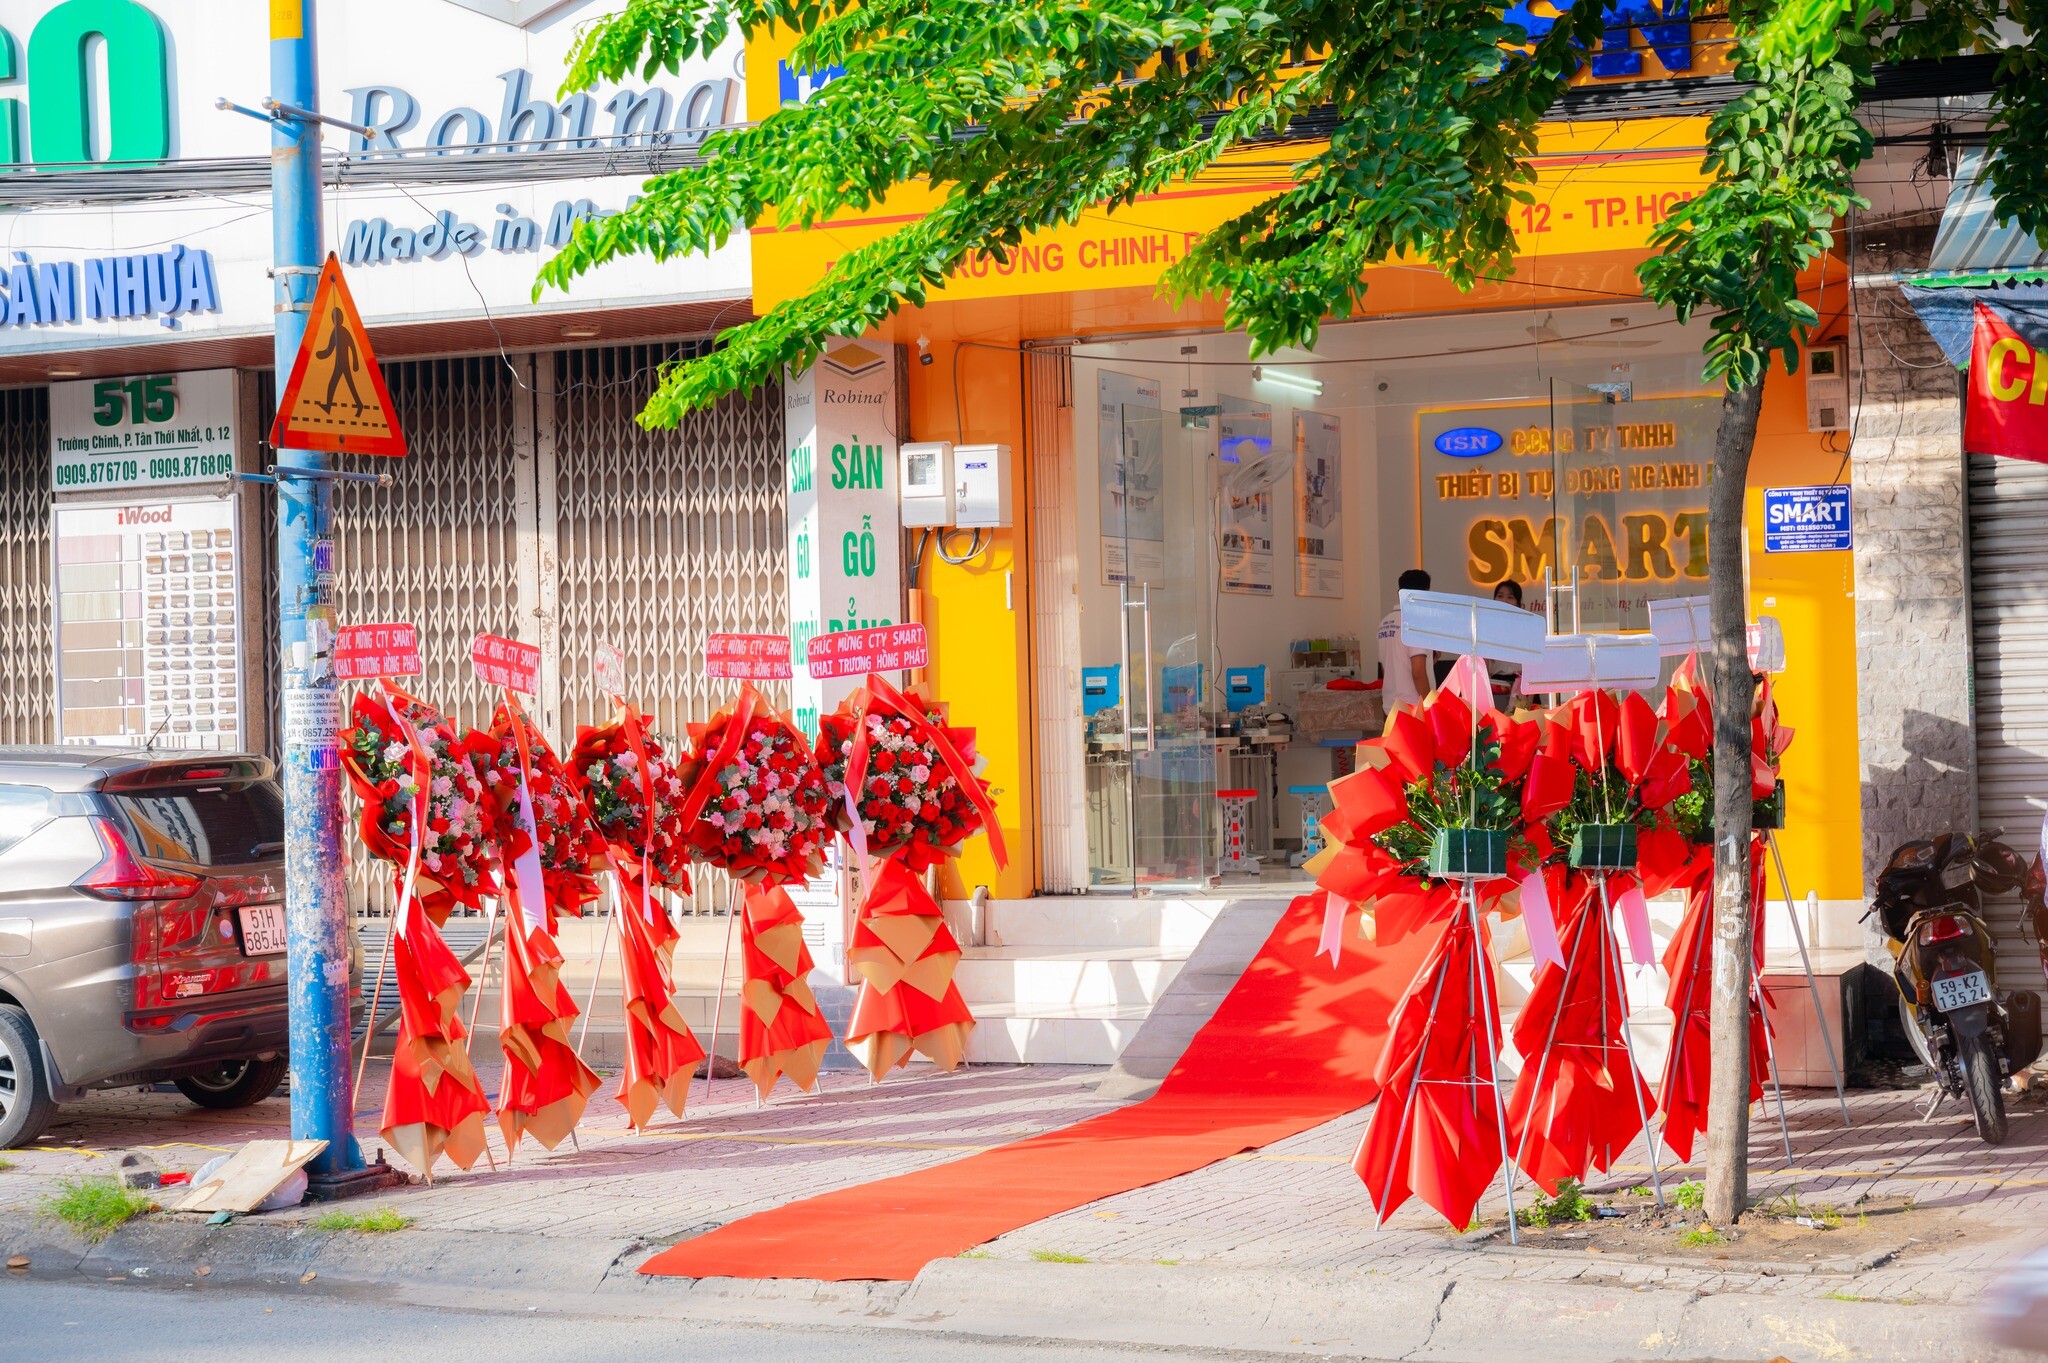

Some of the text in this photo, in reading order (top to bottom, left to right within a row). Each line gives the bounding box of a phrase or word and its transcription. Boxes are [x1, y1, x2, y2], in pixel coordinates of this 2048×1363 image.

[343, 68, 740, 161] Robina
[342, 209, 482, 265] Made
[491, 203, 537, 252] in
[1078, 234, 1177, 268] CHINH,
[84, 244, 218, 328] NHỰA
[93, 377, 177, 427] 515
[57, 437, 90, 452] Trường
[92, 433, 122, 450] Chinh,
[124, 433, 133, 447] P.
[135, 432, 152, 446] Tân
[154, 429, 175, 445] Thới
[205, 426, 216, 442] Q.
[218, 426, 230, 440] 12
[1444, 435, 1489, 452] ISN
[1510, 423, 1675, 457] CÔNG TY TNHH
[831, 434, 883, 490] SÀN
[1435, 465, 1492, 499] THIẾT
[1497, 472, 1519, 500] BỊ
[1627, 460, 1701, 491] NGÀNH
[118, 504, 173, 525] iWood
[1769, 501, 1846, 524] SMART
[842, 515, 876, 577] GỖ
[1467, 509, 1710, 585] SMART
[376, 630, 389, 648] CTY
[392, 629, 415, 648] SMART
[749, 639, 765, 655] CTY
[766, 640, 790, 656] SMART
[808, 627, 923, 656] CHÚC MỪNG CTY SMART
[334, 658, 352, 677] KHAI
[707, 661, 724, 676] KHAI
[811, 661, 833, 677] KHAI
[876, 648, 899, 669] HỒNG
[904, 646, 926, 666] PHÁT
[250, 908, 275, 930] 51H
[246, 929, 287, 952] 585.44
[170, 973, 211, 985] XPANDER
[1940, 975, 1980, 995] 59-K2
[1939, 986, 1989, 1011] 135.24
